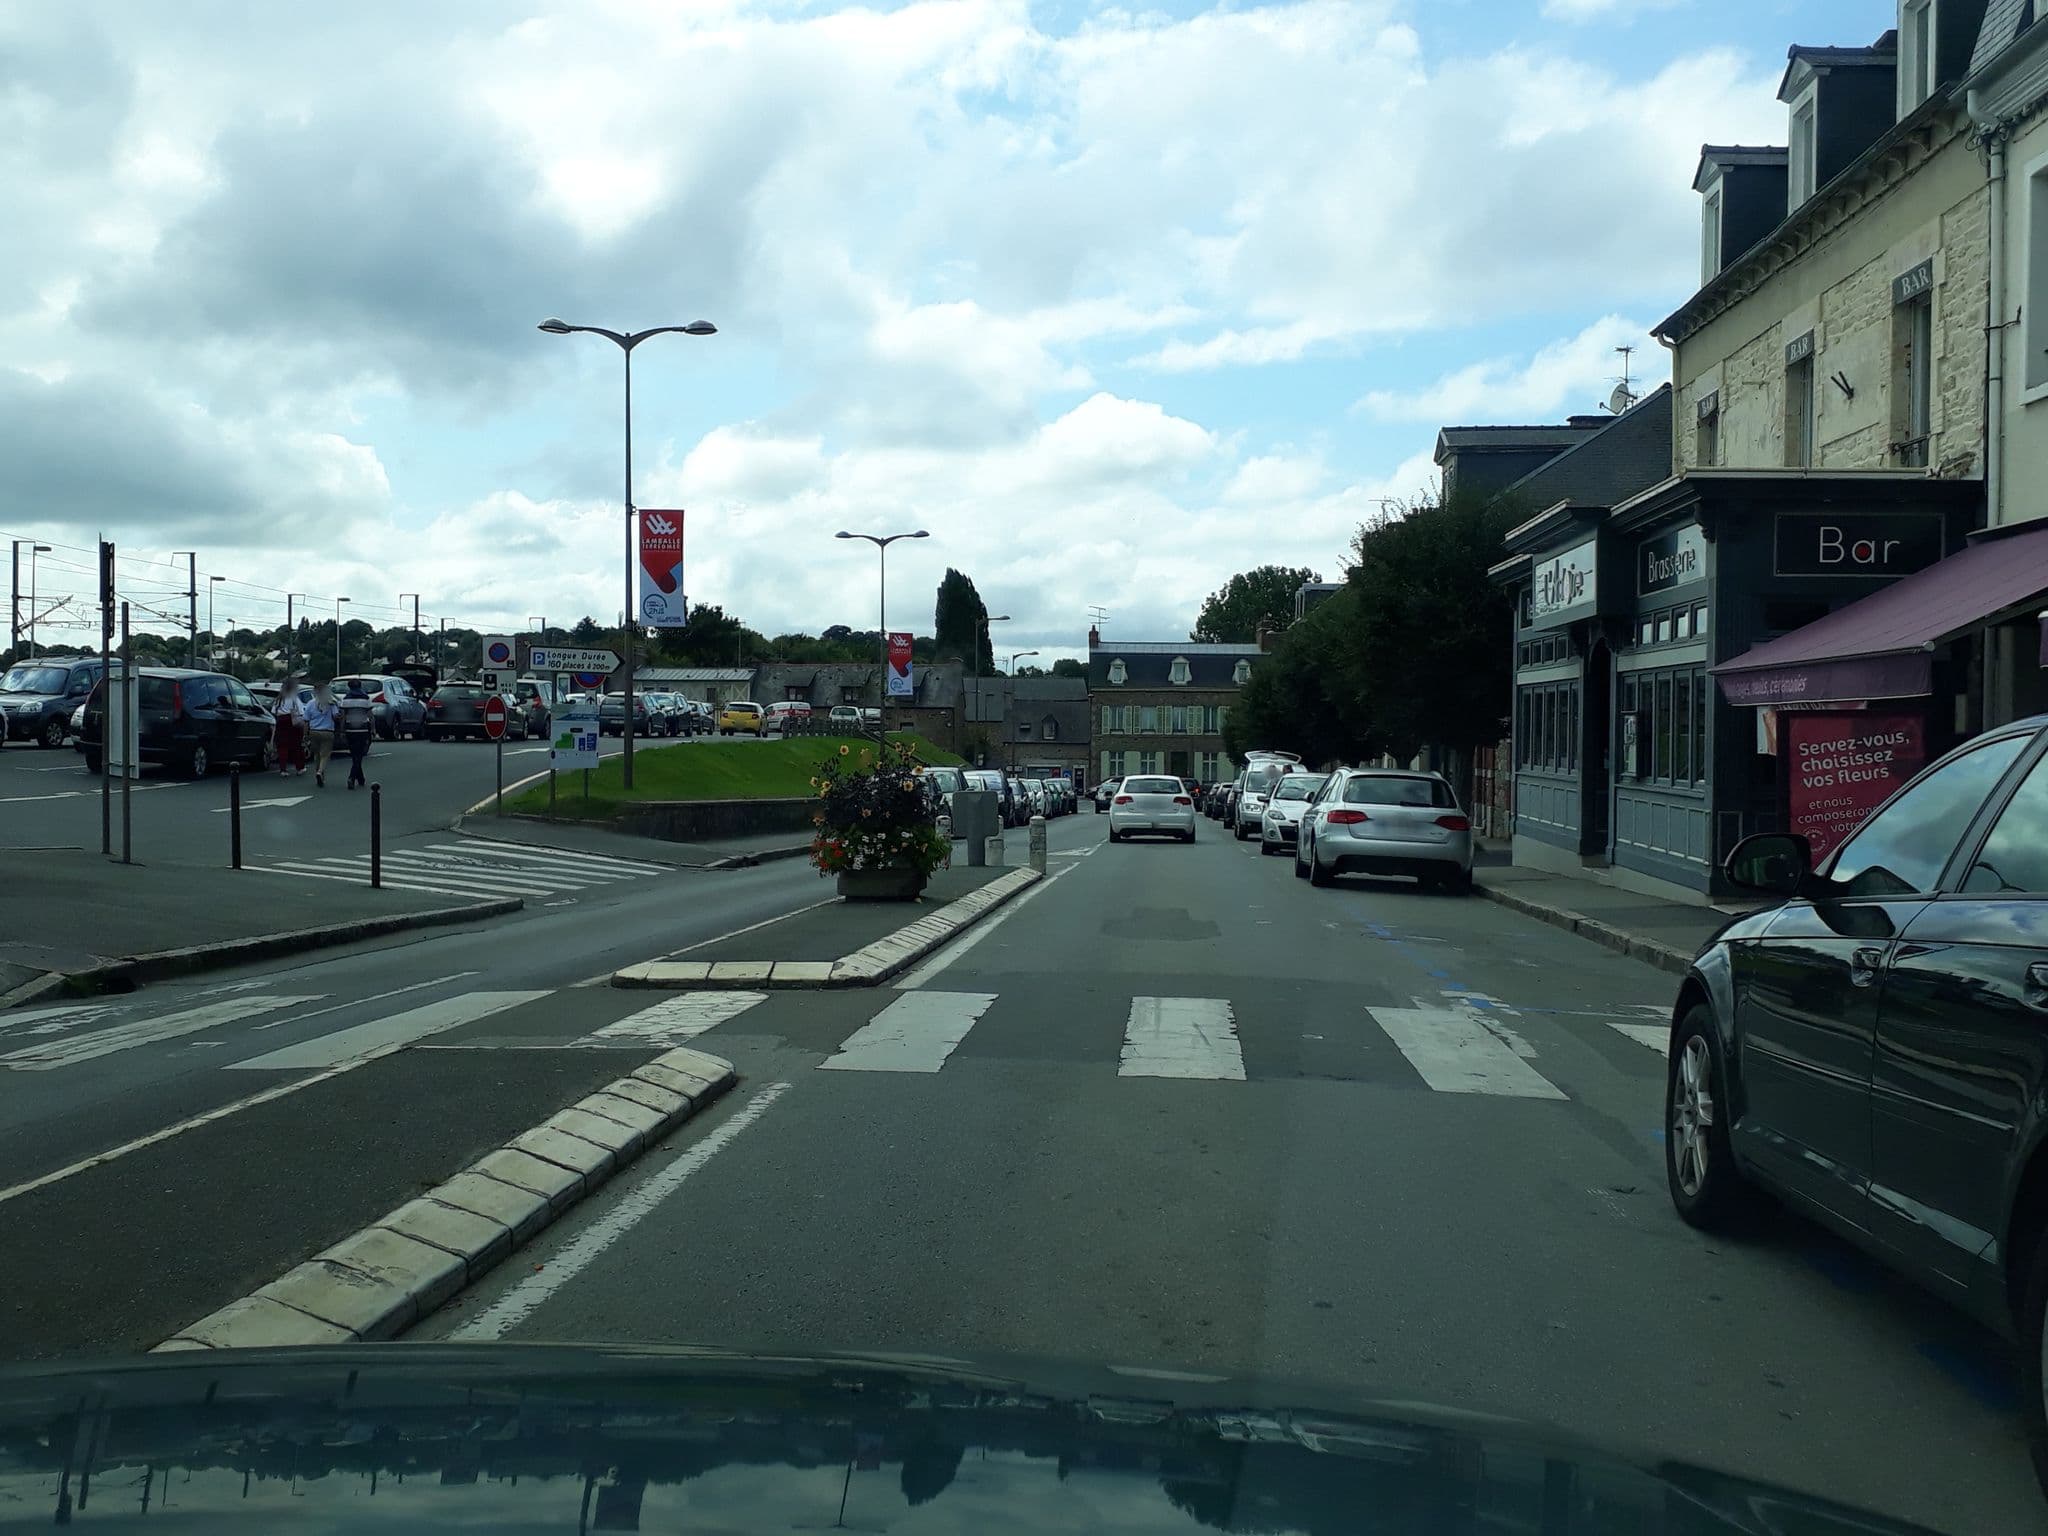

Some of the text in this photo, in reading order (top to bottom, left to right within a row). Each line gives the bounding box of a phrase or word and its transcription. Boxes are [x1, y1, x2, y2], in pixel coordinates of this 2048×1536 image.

[1901, 266, 1930, 297] BAR
[1790, 337, 1808, 361] BAR
[1819, 526, 1901, 564] Bar
[1648, 540, 1696, 583] Brasserie
[547, 651, 606, 662] Longue Durée
[548, 660, 561, 669] 160
[562, 661, 585, 670] places
[1799, 732, 1910, 756] Servez-vous,
[1801, 750, 1894, 772] choisissez
[1803, 767, 1890, 788] vos fleurs
[1808, 796, 1853, 810] et nous
